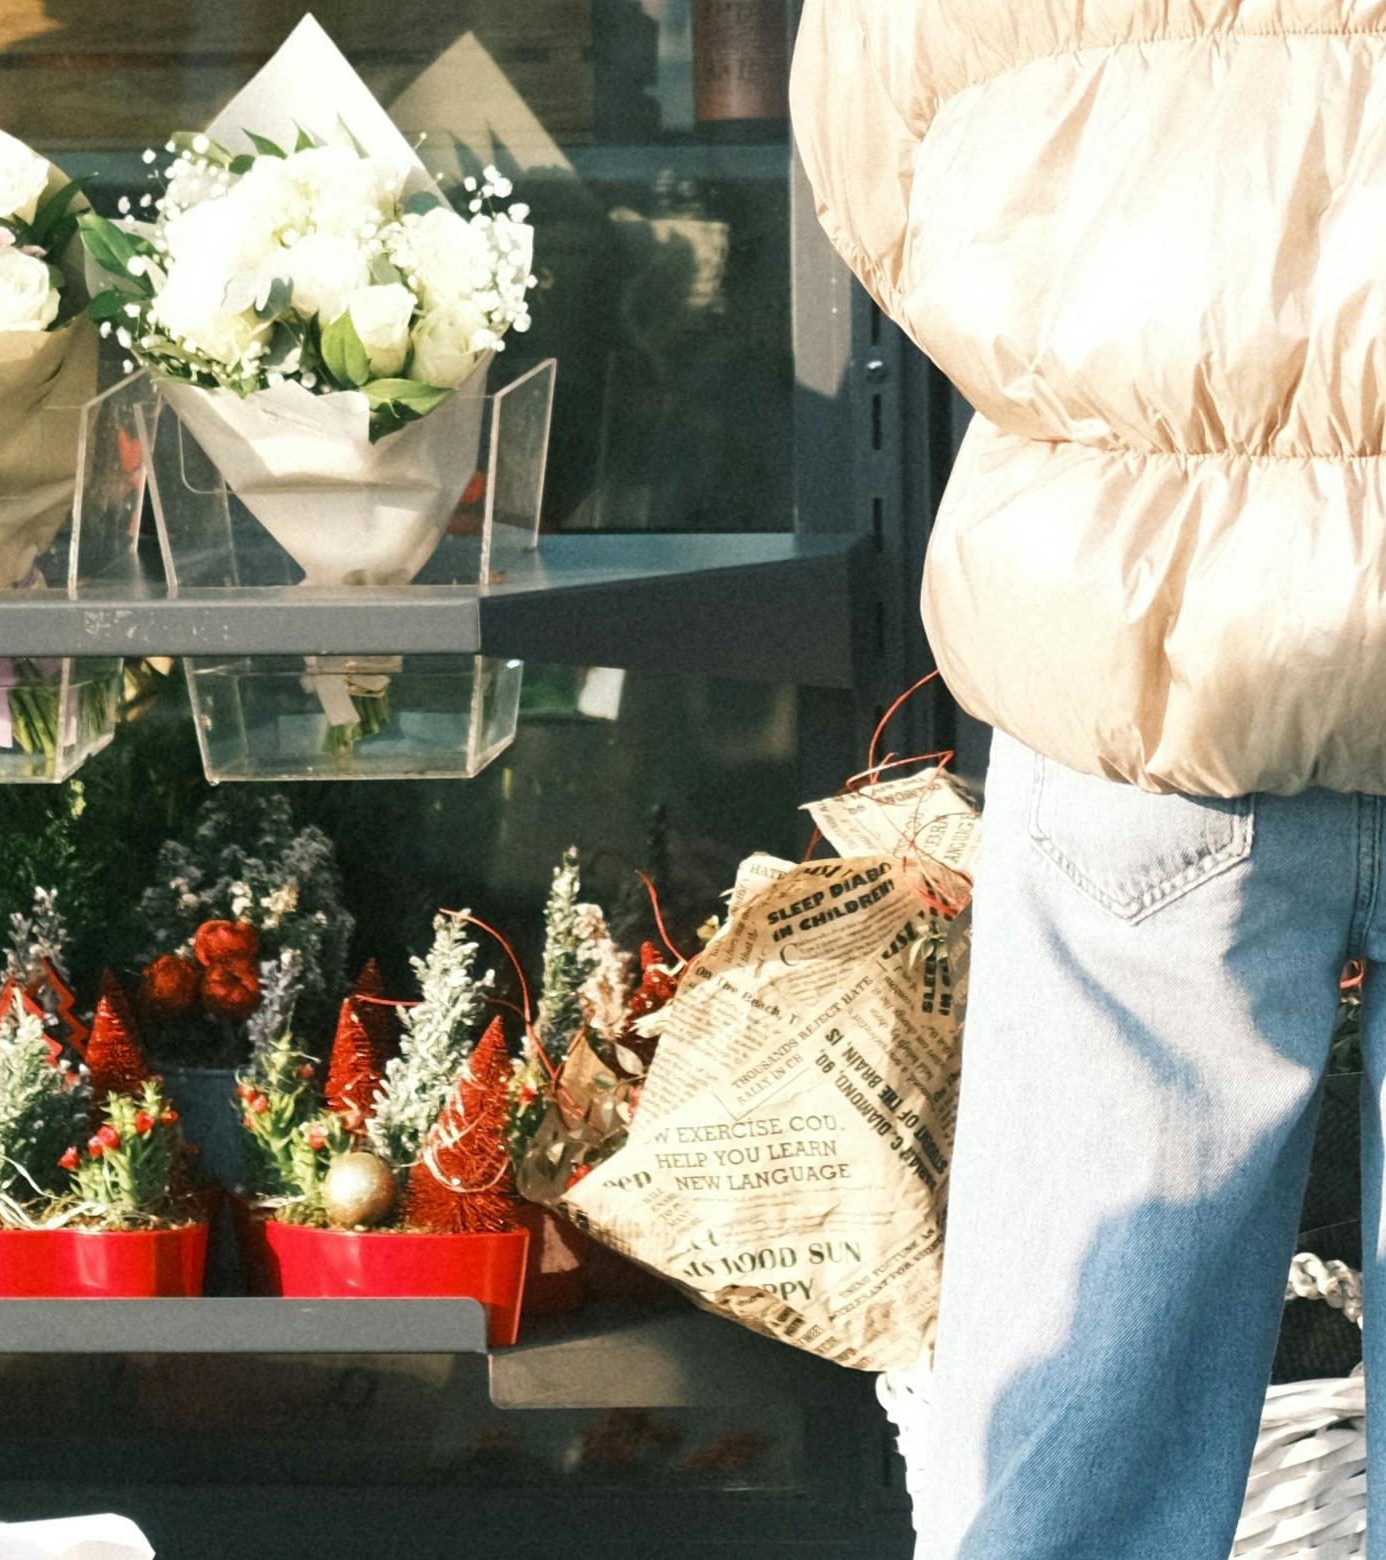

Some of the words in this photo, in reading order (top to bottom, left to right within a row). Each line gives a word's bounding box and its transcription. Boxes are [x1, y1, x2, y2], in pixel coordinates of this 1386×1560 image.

[767, 890, 825, 925] SLEEP
[772, 925, 794, 943] IN
[731, 1038, 800, 1090] THOUSANDS
[799, 1001, 842, 1040] REJECT
[841, 976, 874, 1005] HATE
[877, 1084, 903, 1114] THE
[789, 1114, 843, 1132] COU
[654, 1151, 708, 1169] HELP
[713, 1145, 760, 1167] YOU
[767, 1139, 838, 1161] LEARN
[675, 1175, 721, 1192] NEW
[727, 1163, 852, 1191] LANGUAGE
[807, 1240, 863, 1265] SUN
